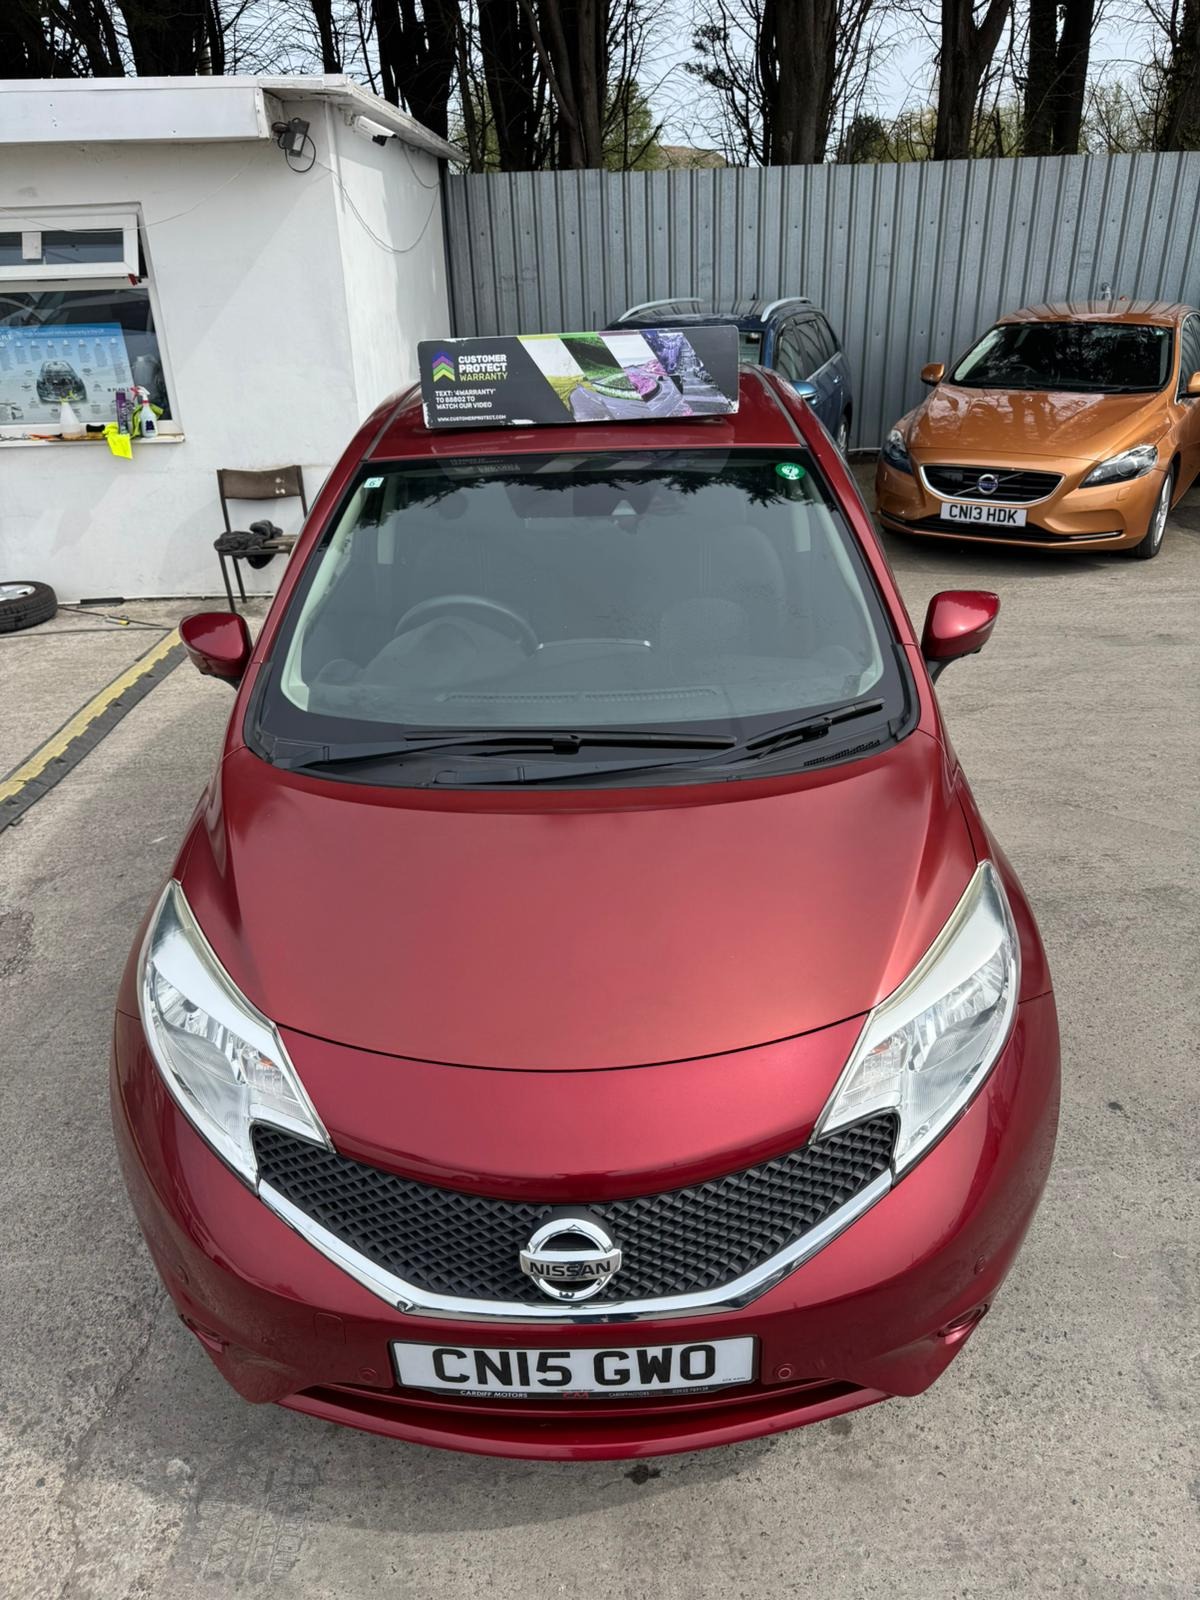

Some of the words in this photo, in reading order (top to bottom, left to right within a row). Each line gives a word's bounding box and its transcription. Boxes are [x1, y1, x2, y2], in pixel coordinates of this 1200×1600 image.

[458, 354, 507, 363] CUSTOMER
[458, 363, 507, 373] PROTECT
[459, 372, 508, 382] WARRANTY
[949, 504, 983, 521] CN13
[986, 507, 1018, 524] HDK
[529, 1261, 611, 1277] NISSAN
[432, 1347, 572, 1387] CN15
[593, 1344, 717, 1386] GWO
[493, 1391, 528, 1399] MOTORS
